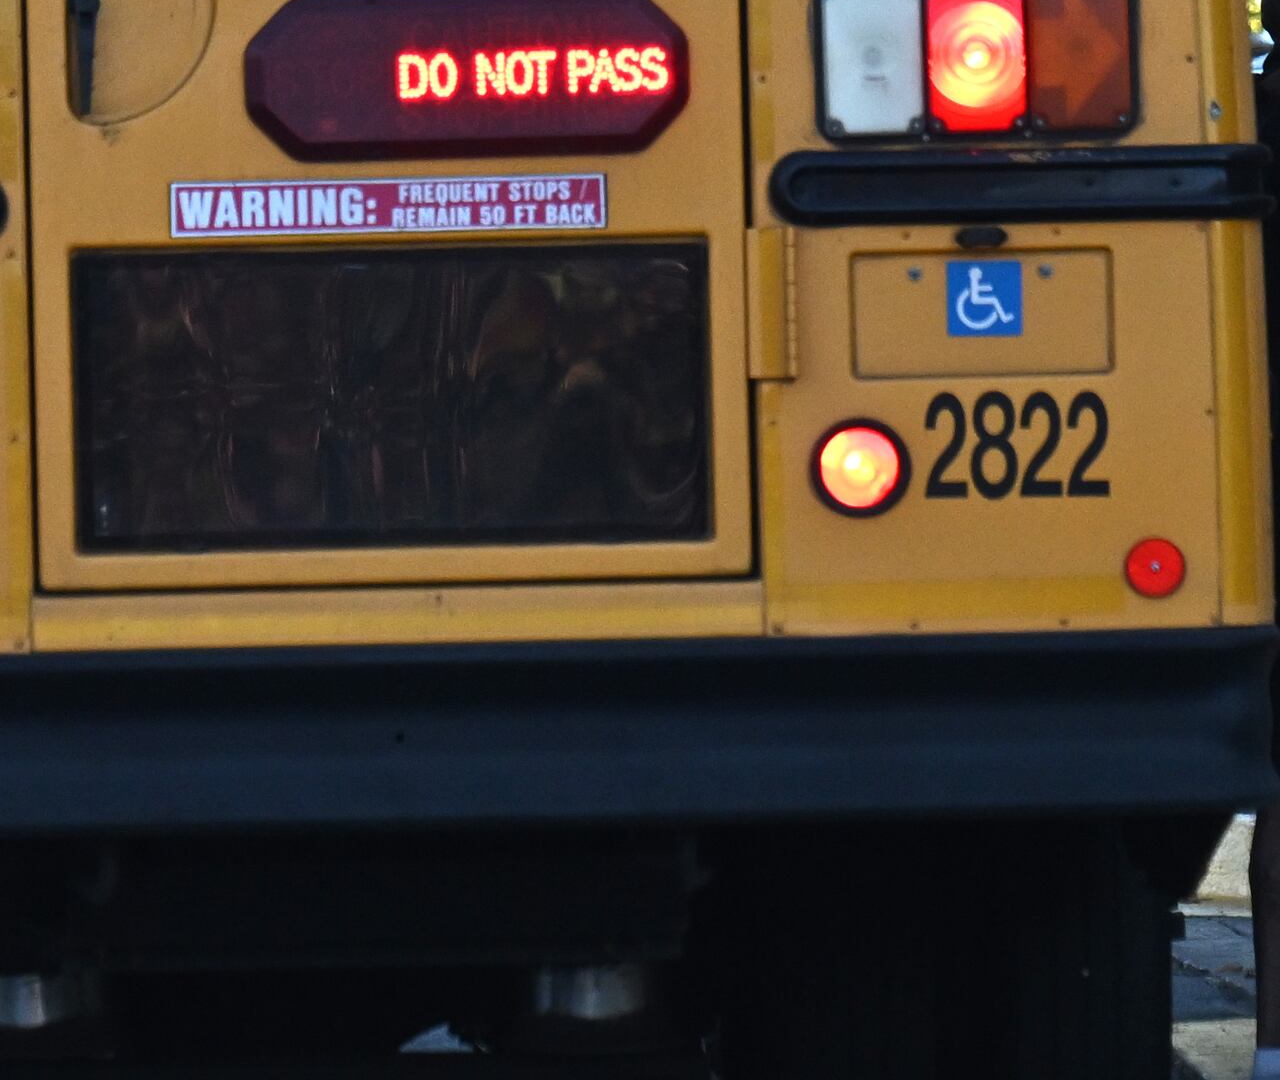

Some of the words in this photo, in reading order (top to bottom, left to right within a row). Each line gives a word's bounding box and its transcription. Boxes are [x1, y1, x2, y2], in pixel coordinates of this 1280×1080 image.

[397, 52, 458, 99] DO
[474, 50, 556, 97] NOT
[566, 47, 670, 94] PASS
[178, 188, 377, 230] WARNING:
[397, 183, 500, 203] FREQUENT
[508, 181, 571, 201] STOPS
[391, 206, 472, 228] REMAIN
[479, 204, 505, 226] 50
[513, 203, 536, 224] FT
[544, 201, 596, 224] BACK
[925, 391, 1110, 500] 2822
